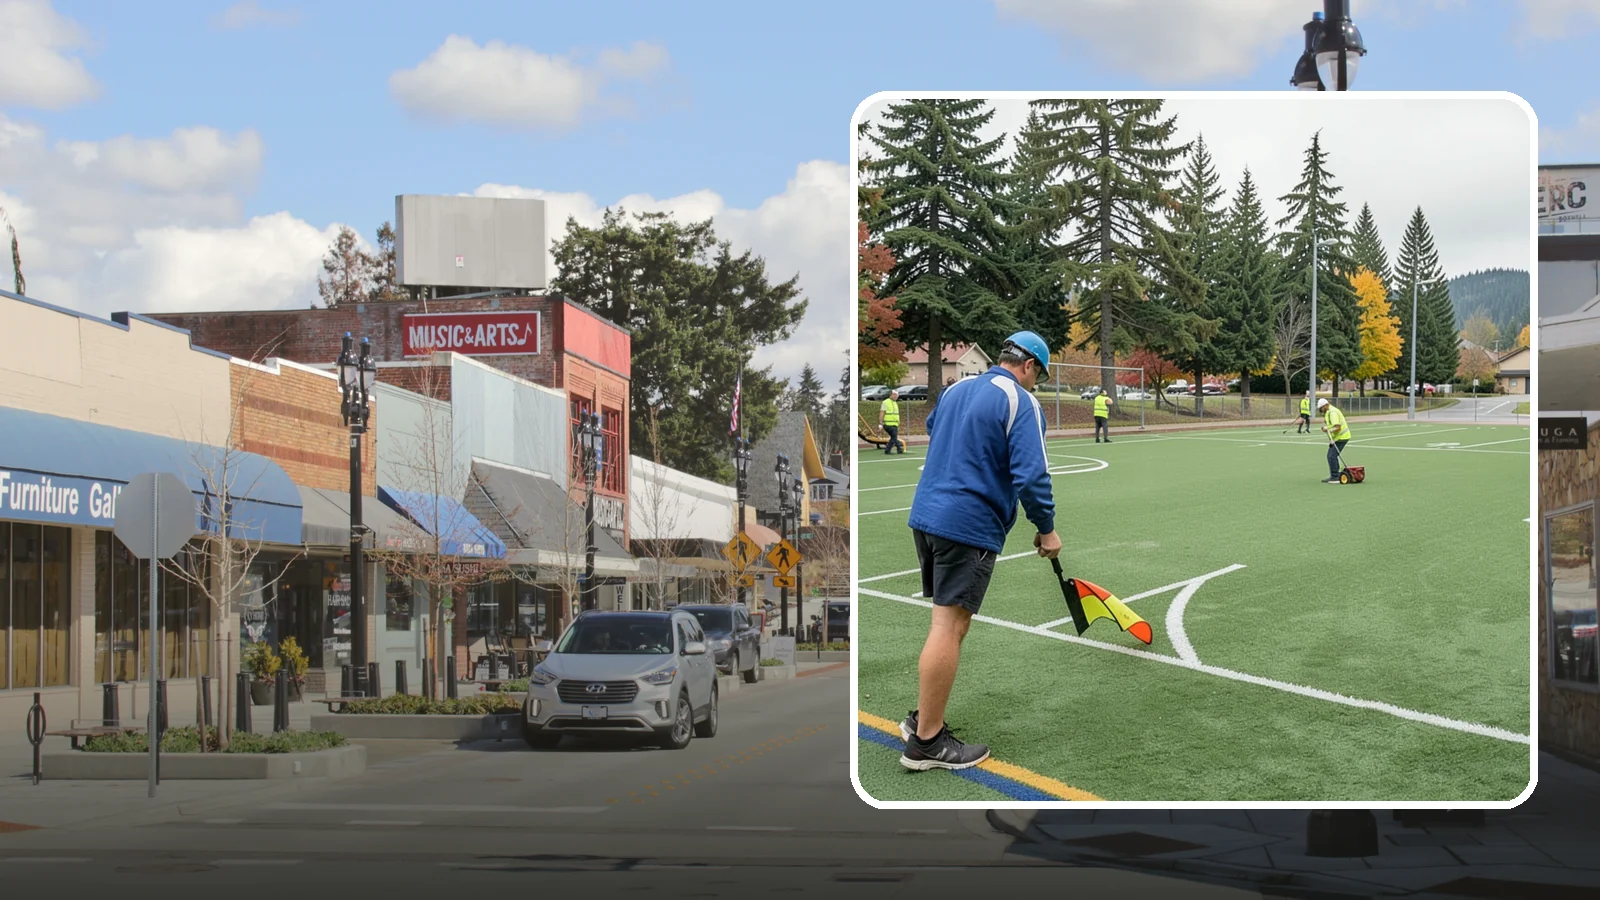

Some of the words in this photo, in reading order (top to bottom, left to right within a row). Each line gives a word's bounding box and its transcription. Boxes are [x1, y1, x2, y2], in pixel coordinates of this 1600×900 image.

[1540, 428, 1577, 436] UGA
[0, 471, 79, 516] Furniture
[89, 482, 122, 519] Gal
